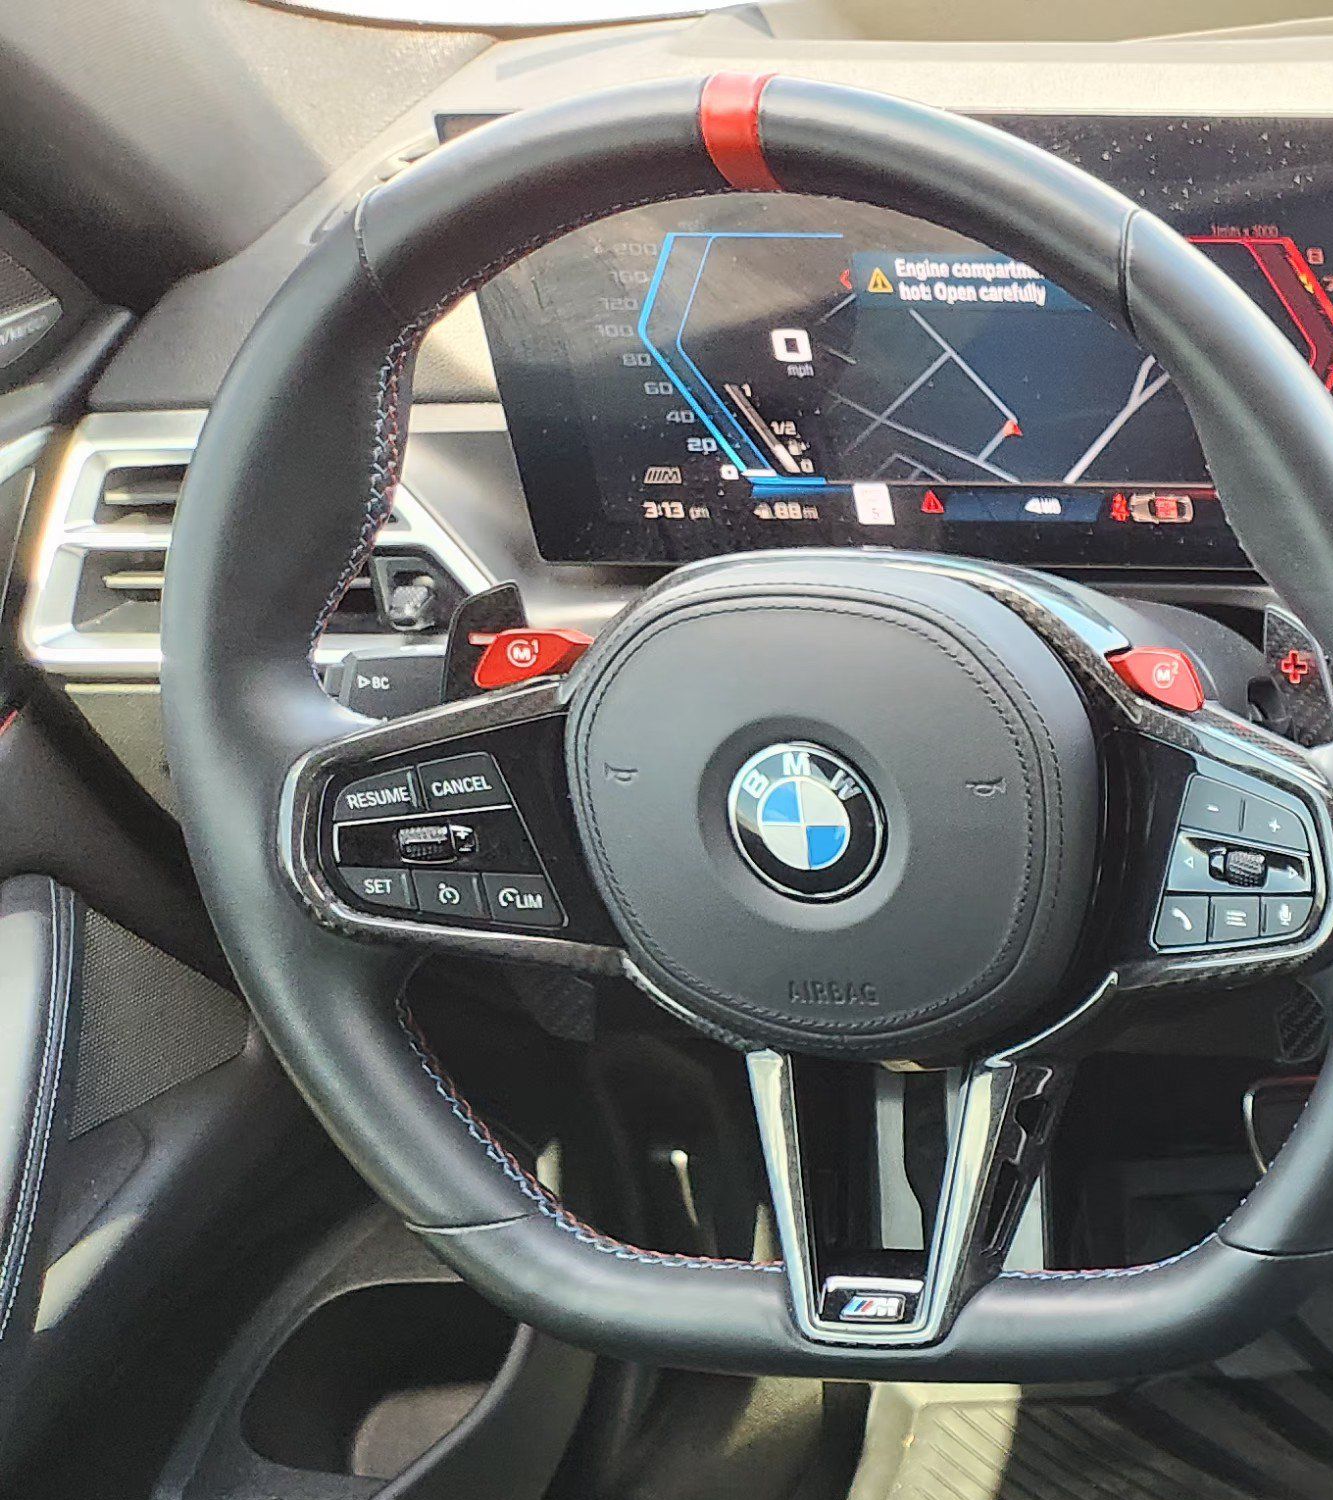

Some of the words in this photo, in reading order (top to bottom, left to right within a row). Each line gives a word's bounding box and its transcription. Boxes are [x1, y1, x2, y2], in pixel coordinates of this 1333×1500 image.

[895, 258, 950, 281] Engine
[934, 282, 978, 304] Open
[978, 282, 1047, 306] carefully
[595, 324, 634, 338] 100
[622, 353, 651, 367] 80
[787, 364, 815, 379] mph
[644, 381, 673, 395] 60
[665, 409, 695, 424] 40
[771, 420, 797, 435] 1/2
[686, 437, 718, 452] 20
[719, 464, 739, 481] 0
[371, 675, 390, 690] BC
[741, 752, 862, 801] BMW
[431, 775, 492, 797] CANCEL
[346, 786, 411, 811] RESUME
[364, 878, 393, 895] SET
[515, 893, 543, 909] LIM
[788, 979, 880, 1006] AIRBAG
